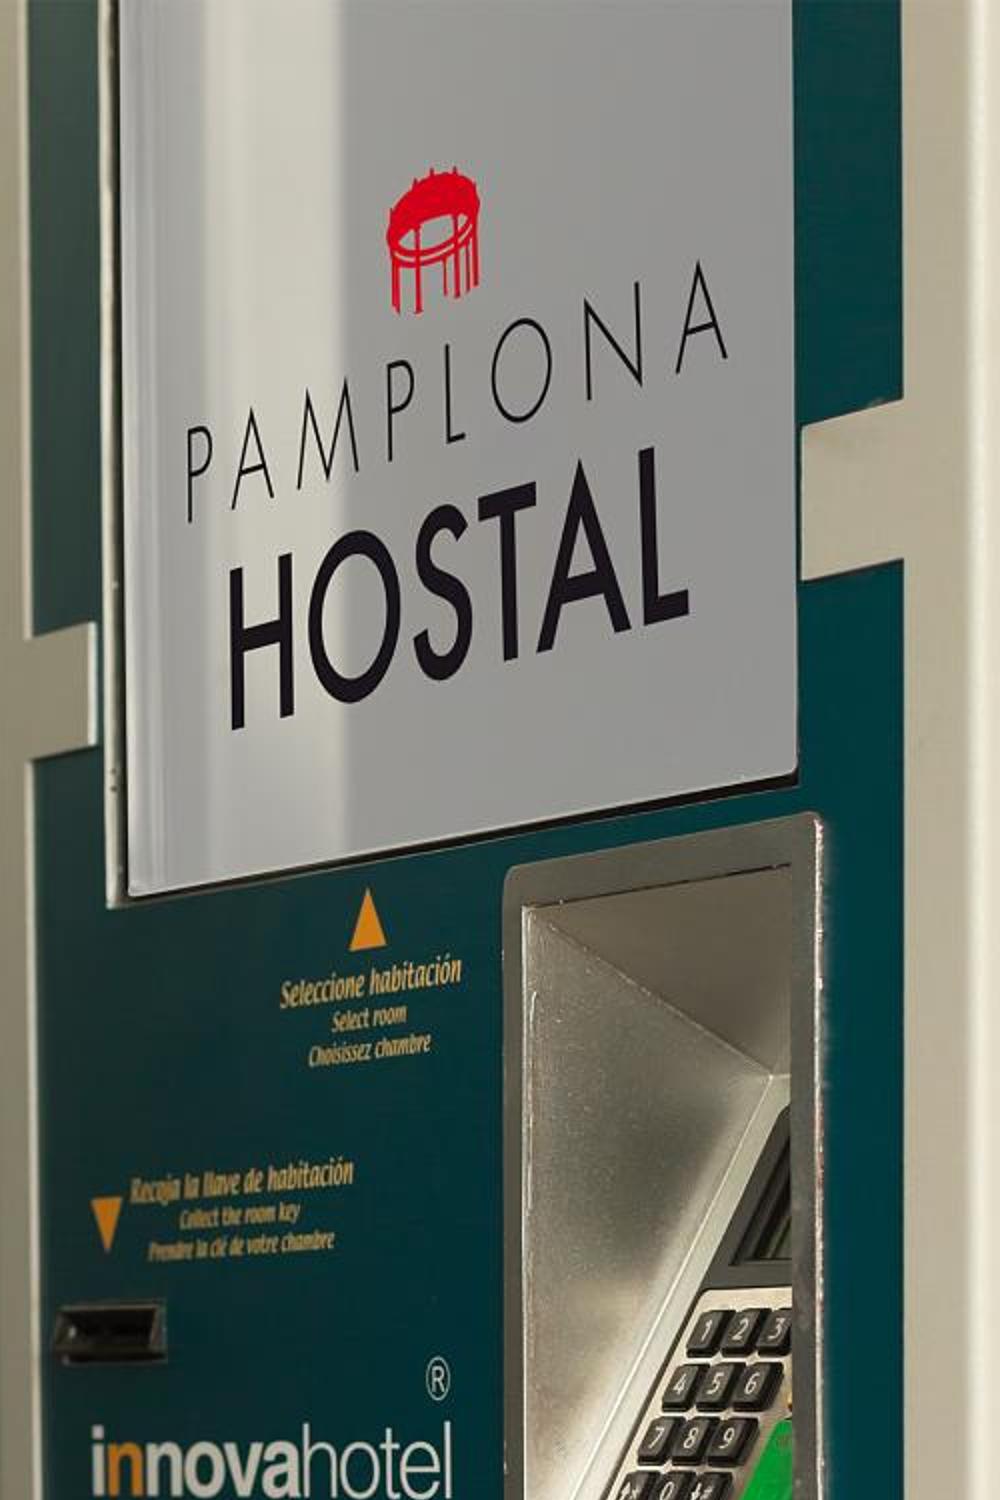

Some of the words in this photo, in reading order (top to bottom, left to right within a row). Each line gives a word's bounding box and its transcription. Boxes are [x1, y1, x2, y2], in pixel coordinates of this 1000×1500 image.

[186, 260, 728, 524] PAMPLONA
[228, 446, 690, 731] HOSTAL
[280, 972, 365, 1009] Seleccione
[369, 953, 462, 996] habitación
[331, 1008, 370, 1033] Select
[373, 1005, 408, 1027] room
[308, 1040, 372, 1068] Choisissez
[375, 1032, 432, 1059] chambre
[130, 1174, 181, 1205] Recoja
[183, 1172, 199, 1200] la
[203, 1170, 240, 1197] llave
[243, 1167, 264, 1195] de
[267, 1156, 355, 1192] habitación
[179, 1207, 219, 1231] Collect
[221, 1205, 241, 1227] the
[244, 1205, 276, 1225] room
[279, 1200, 302, 1225] key
[195, 1237, 209, 1259] la
[229, 1235, 245, 1257] de
[247, 1233, 280, 1255] votre
[281, 1229, 335, 1253] chambre
[701, 1319, 713, 1342] 1
[732, 1318, 748, 1341] 2
[768, 1317, 786, 1340] 3
[674, 1372, 687, 1396] 4
[708, 1371, 725, 1395] 5
[745, 1372, 759, 1395] 6
[650, 1426, 665, 1450] 7
[683, 1427, 698, 1449] 8
[720, 1425, 736, 1449] 9
[91, 1420, 453, 1500] innovahotel
